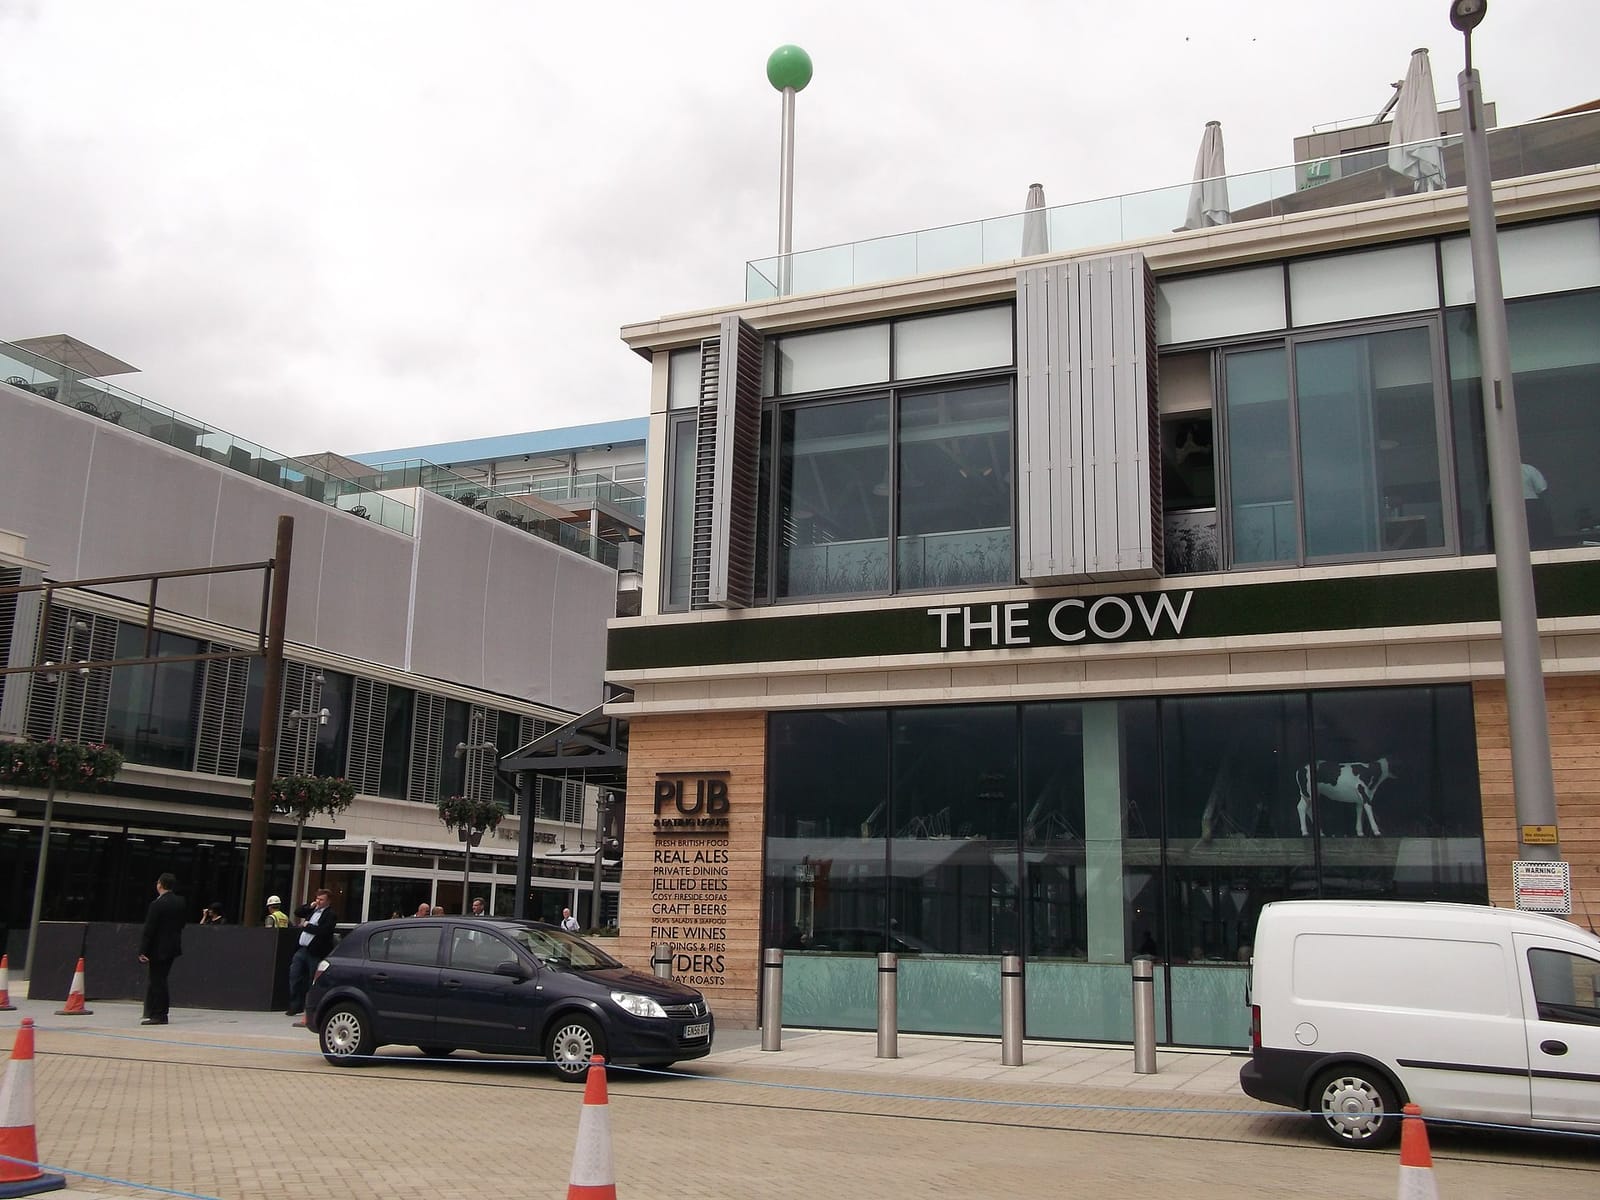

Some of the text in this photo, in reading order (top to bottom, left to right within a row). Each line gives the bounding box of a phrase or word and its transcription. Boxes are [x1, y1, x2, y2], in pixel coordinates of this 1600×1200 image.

[927, 591, 1194, 648] THE COW
[653, 779, 730, 815] PUB
[653, 818, 729, 827] & EATING HOUSE
[655, 839, 729, 847] FRESH BRITISH FOOD
[654, 849, 729, 864] REAL ALES
[653, 866, 728, 876] PRIVATE DINING
[651, 878, 728, 893] JELLIED EELS
[652, 893, 674, 901] COSY
[674, 893, 704, 901] FIRESIDE
[652, 904, 727, 915] CRAFT BEERS
[651, 926, 726, 940] FINE WINES
[699, 943, 706, 952] &
[708, 943, 726, 952] PIES
[689, 976, 725, 985] ROASTS
